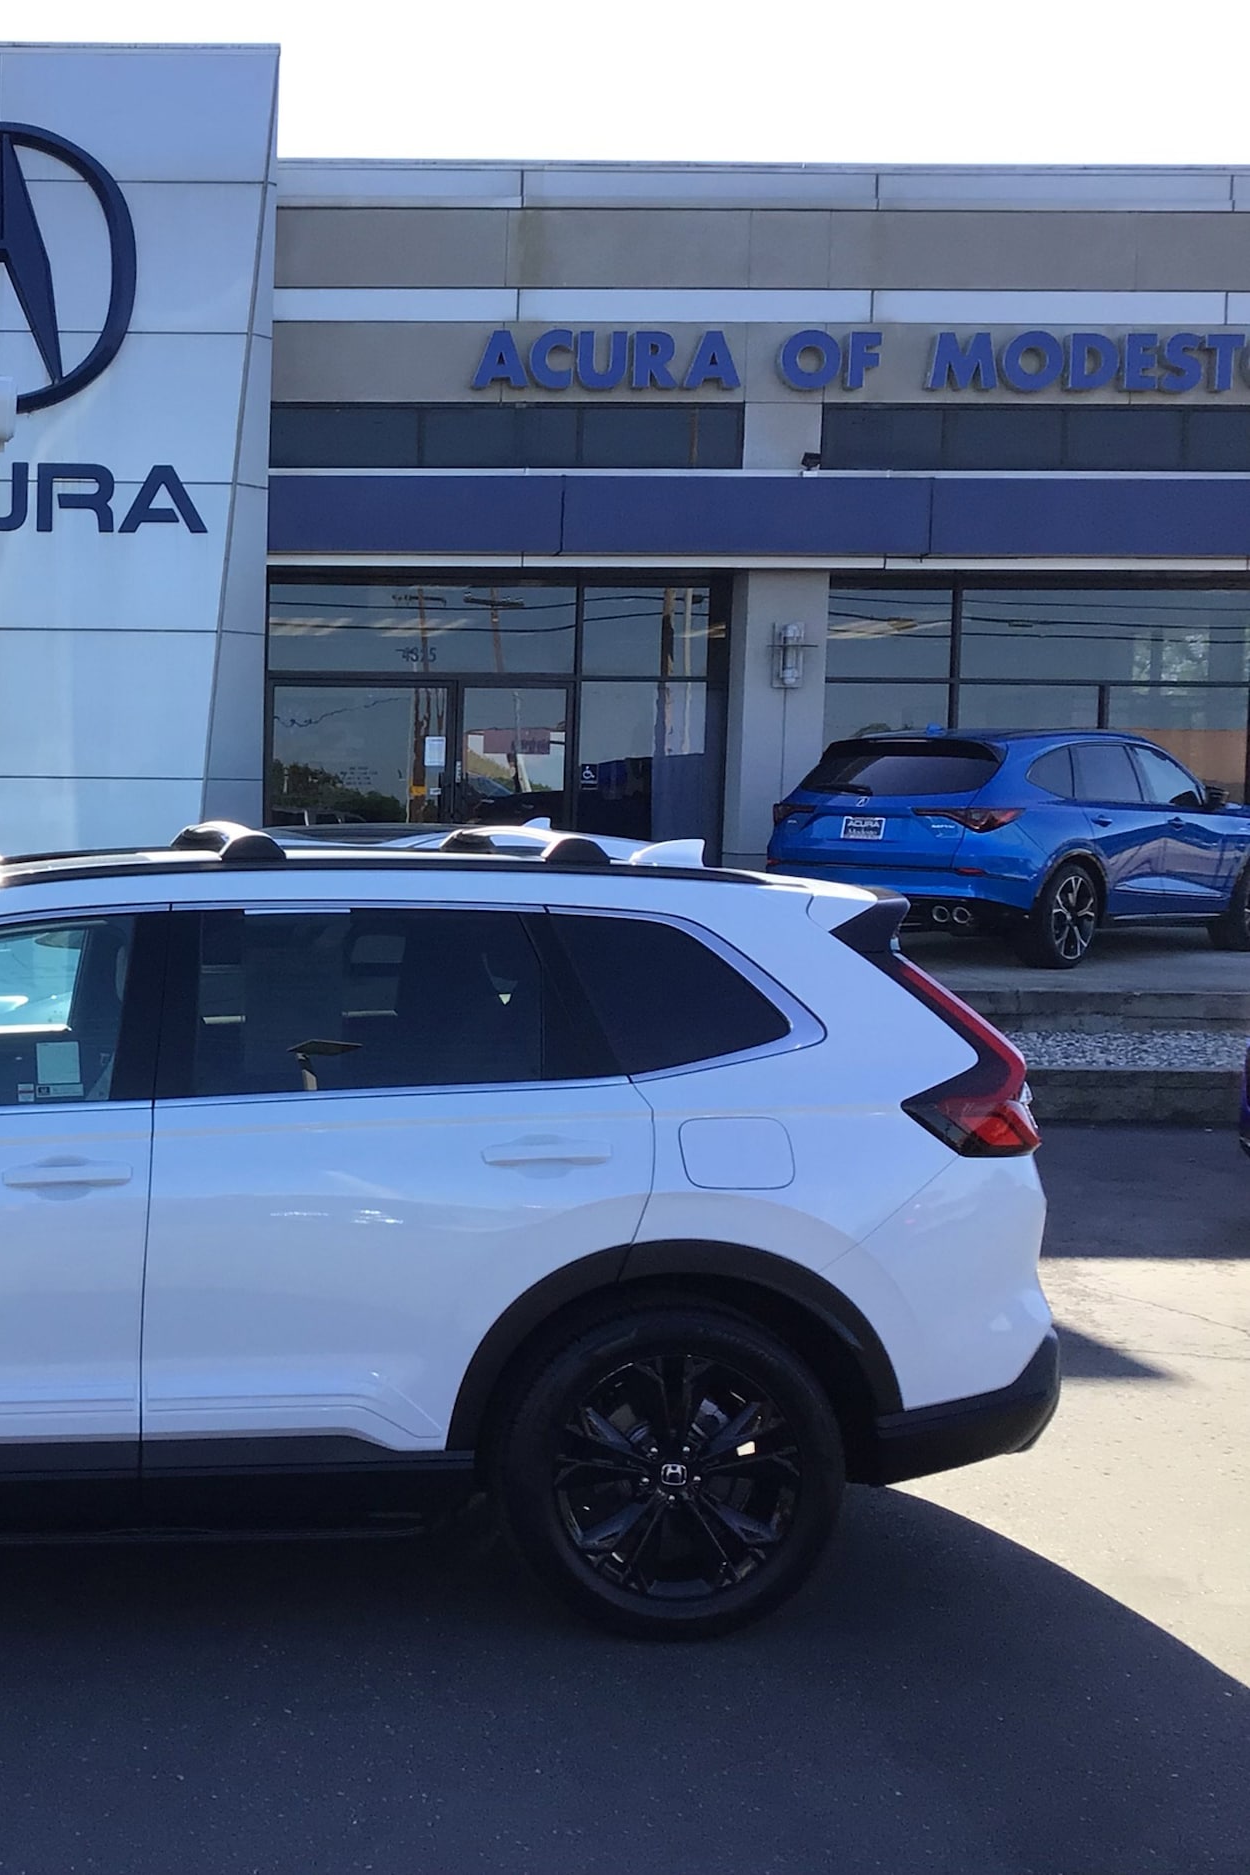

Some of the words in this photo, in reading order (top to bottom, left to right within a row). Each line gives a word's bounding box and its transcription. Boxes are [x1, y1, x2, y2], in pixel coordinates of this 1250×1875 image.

[471, 329, 742, 390] ACURA
[778, 328, 883, 391] OF
[926, 329, 1250, 392] MODEST
[847, 820, 880, 828] ACURA
